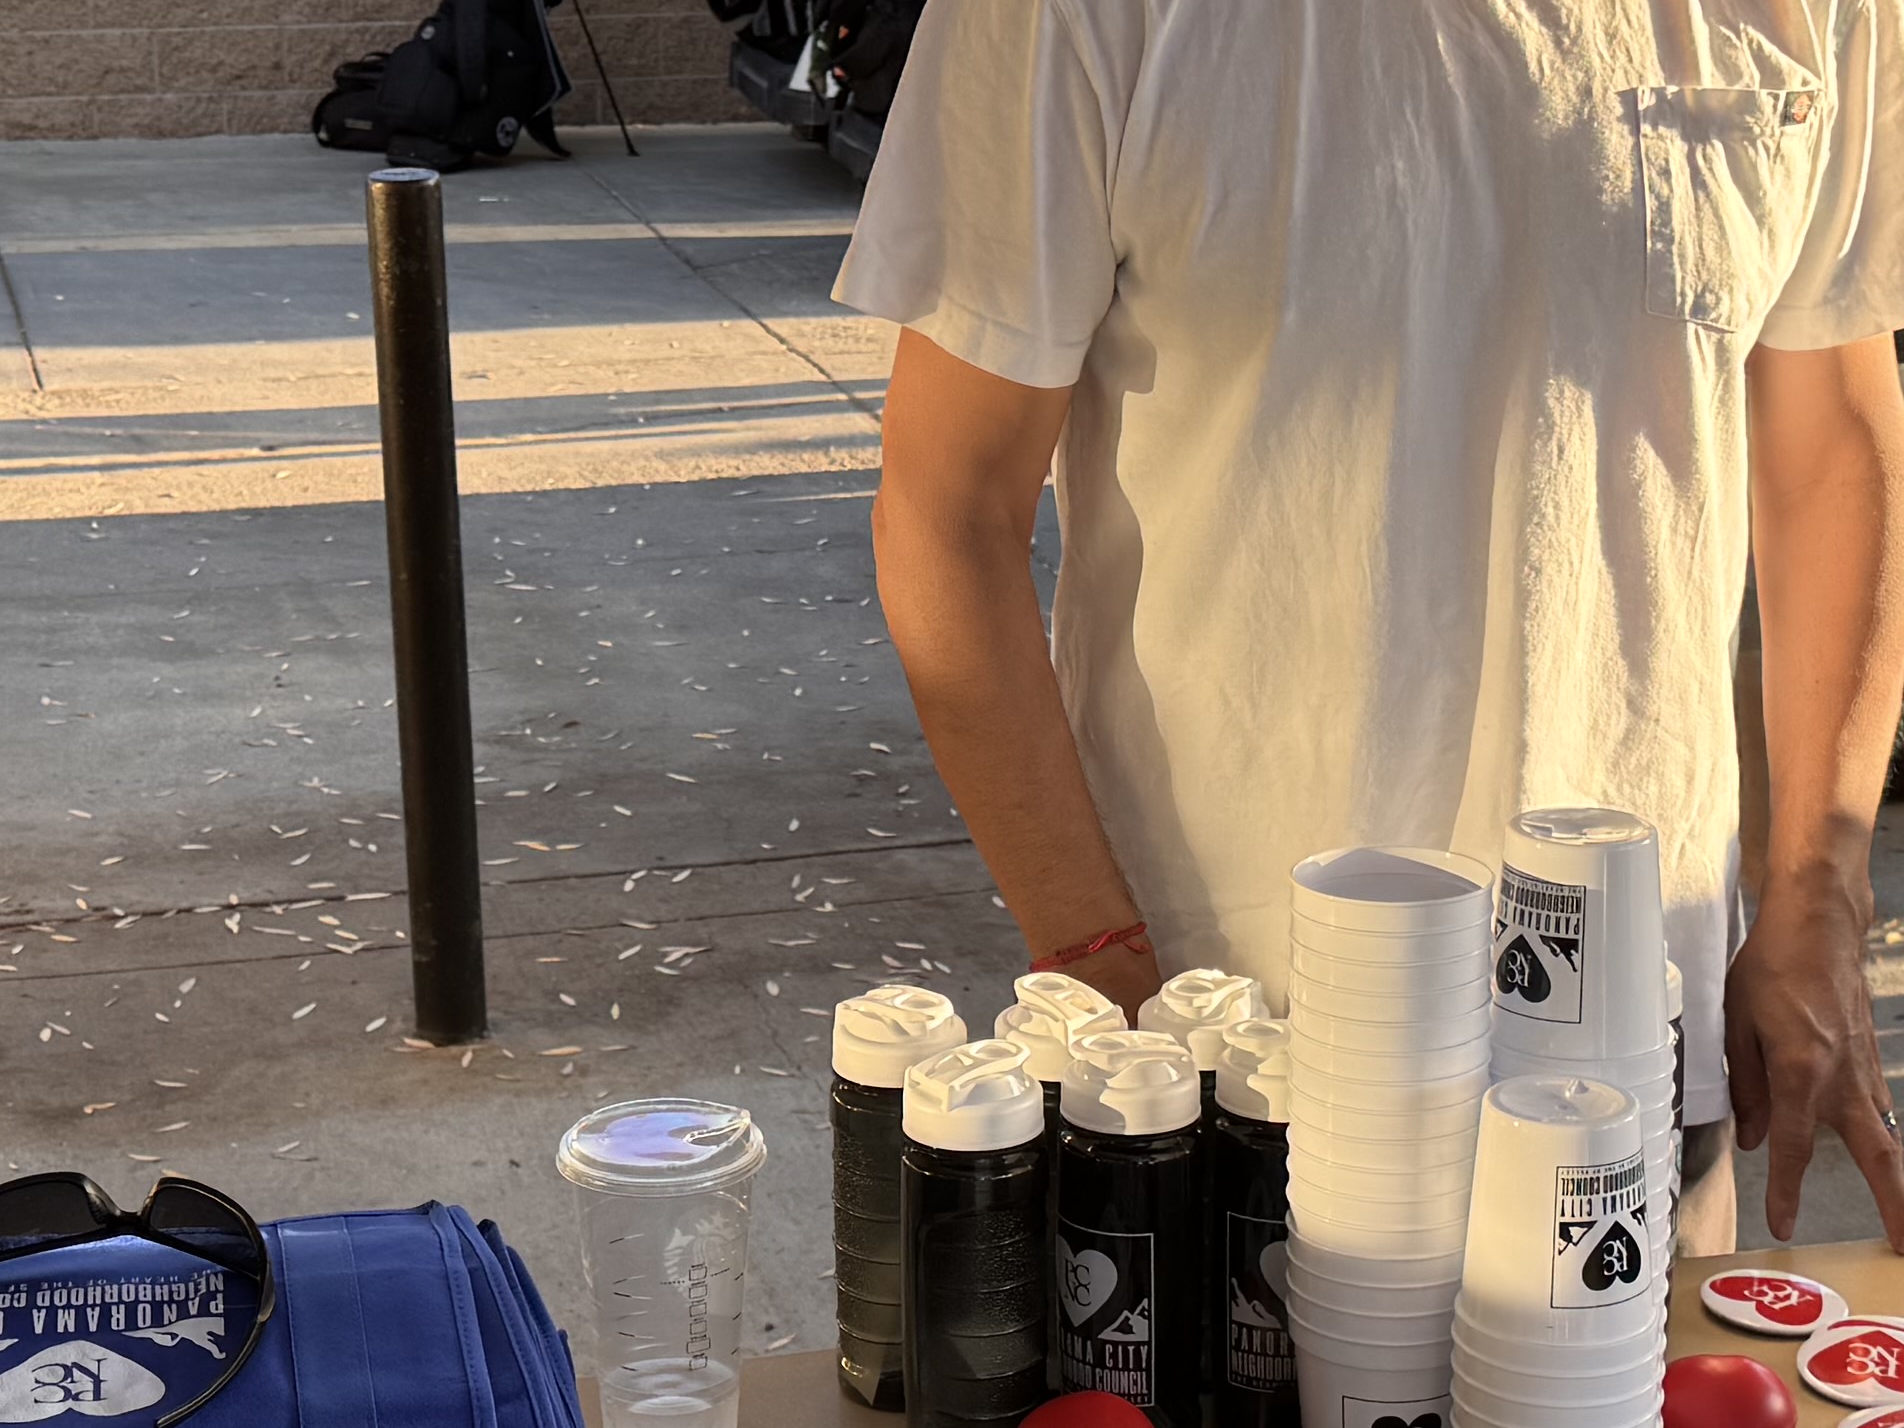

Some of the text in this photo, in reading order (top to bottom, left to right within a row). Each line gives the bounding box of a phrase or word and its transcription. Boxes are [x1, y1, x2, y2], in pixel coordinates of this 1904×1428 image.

[1560, 1198, 1593, 1218] CITY
[36, 1273, 225, 1307] NEIGHBORHOOD
[33, 1293, 225, 1335] PANORAMA
[1231, 1324, 1289, 1356] PANOR
[1105, 1344, 1149, 1369] CITY
[31, 1358, 107, 1385] NC
[1096, 1368, 1149, 1395] COUNCIL
[33, 1384, 107, 1403] PC
